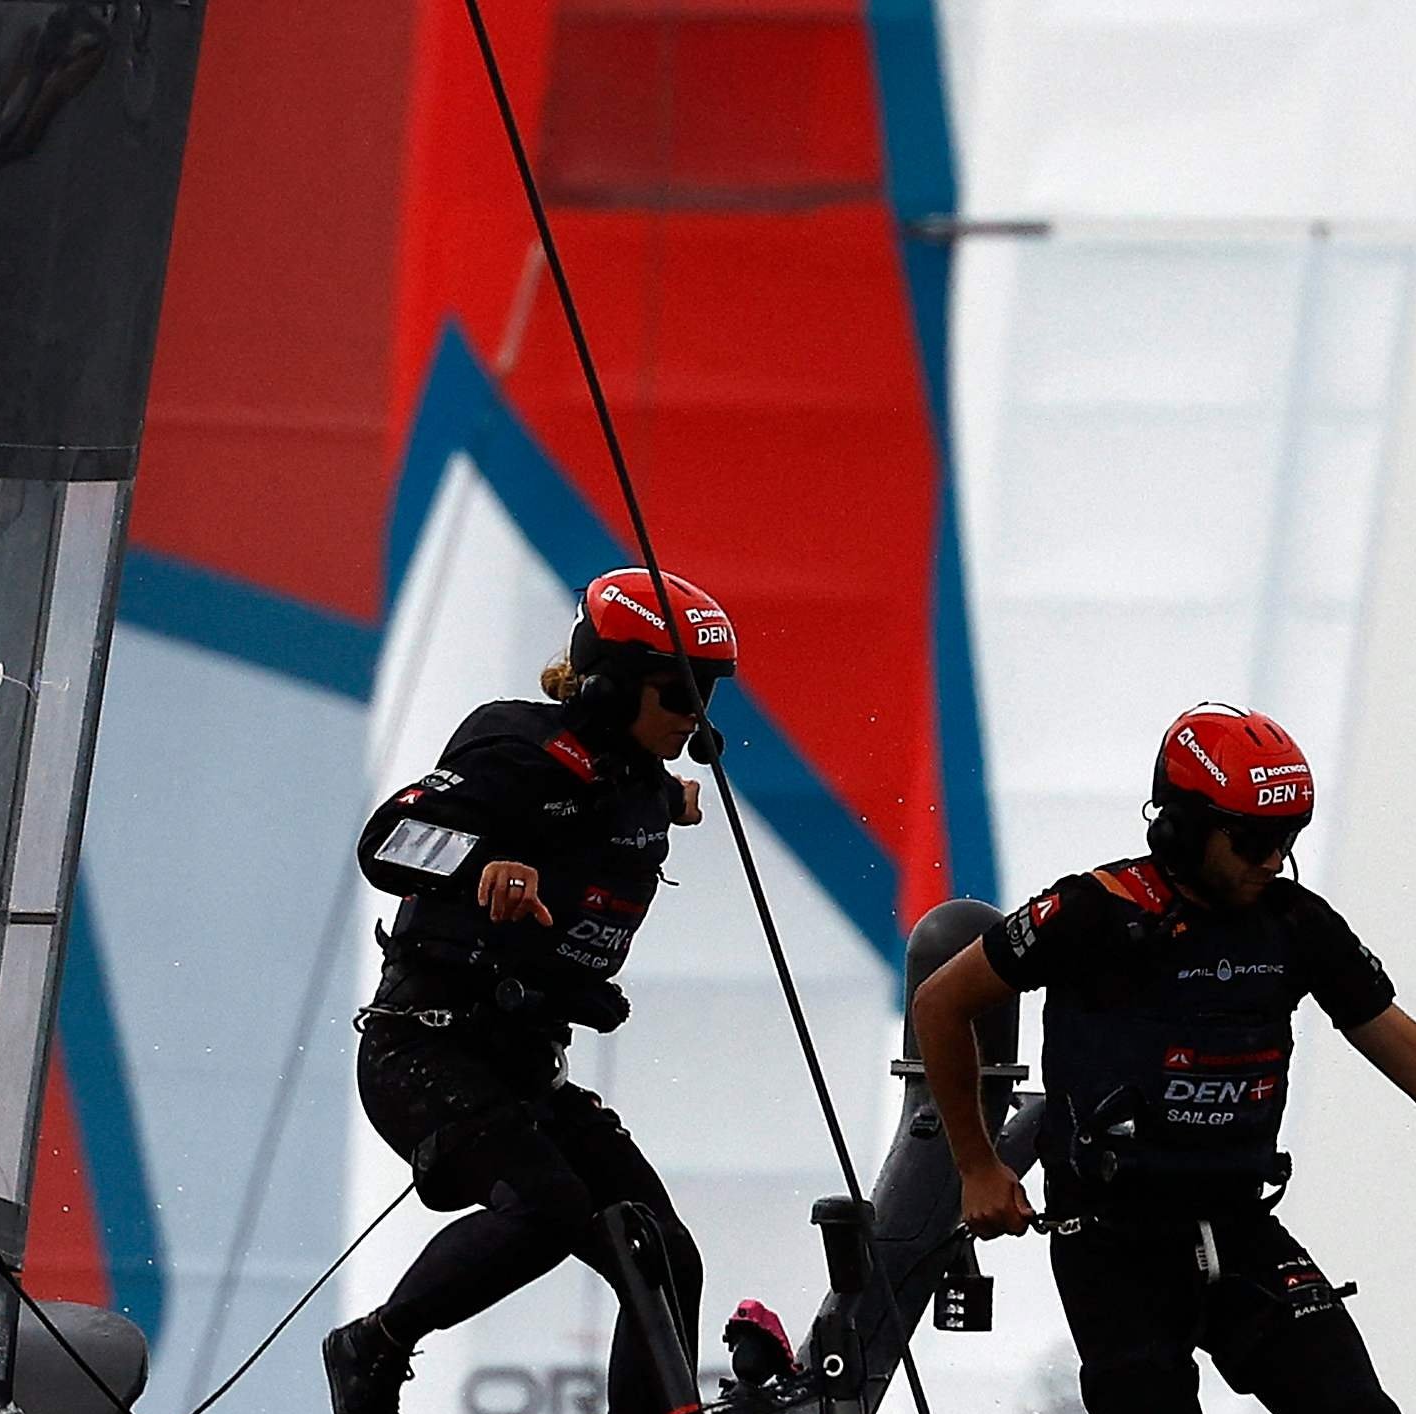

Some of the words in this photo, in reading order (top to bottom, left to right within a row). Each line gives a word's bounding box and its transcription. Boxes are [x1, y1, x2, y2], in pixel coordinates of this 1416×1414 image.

[615, 594, 667, 631] ROCKWOOL
[697, 626, 728, 646] DEN
[1187, 739, 1228, 788] ROCKWOOL
[1257, 784, 1297, 807] DEN
[567, 919, 630, 951] DEN
[1163, 1079, 1248, 1104] DEN
